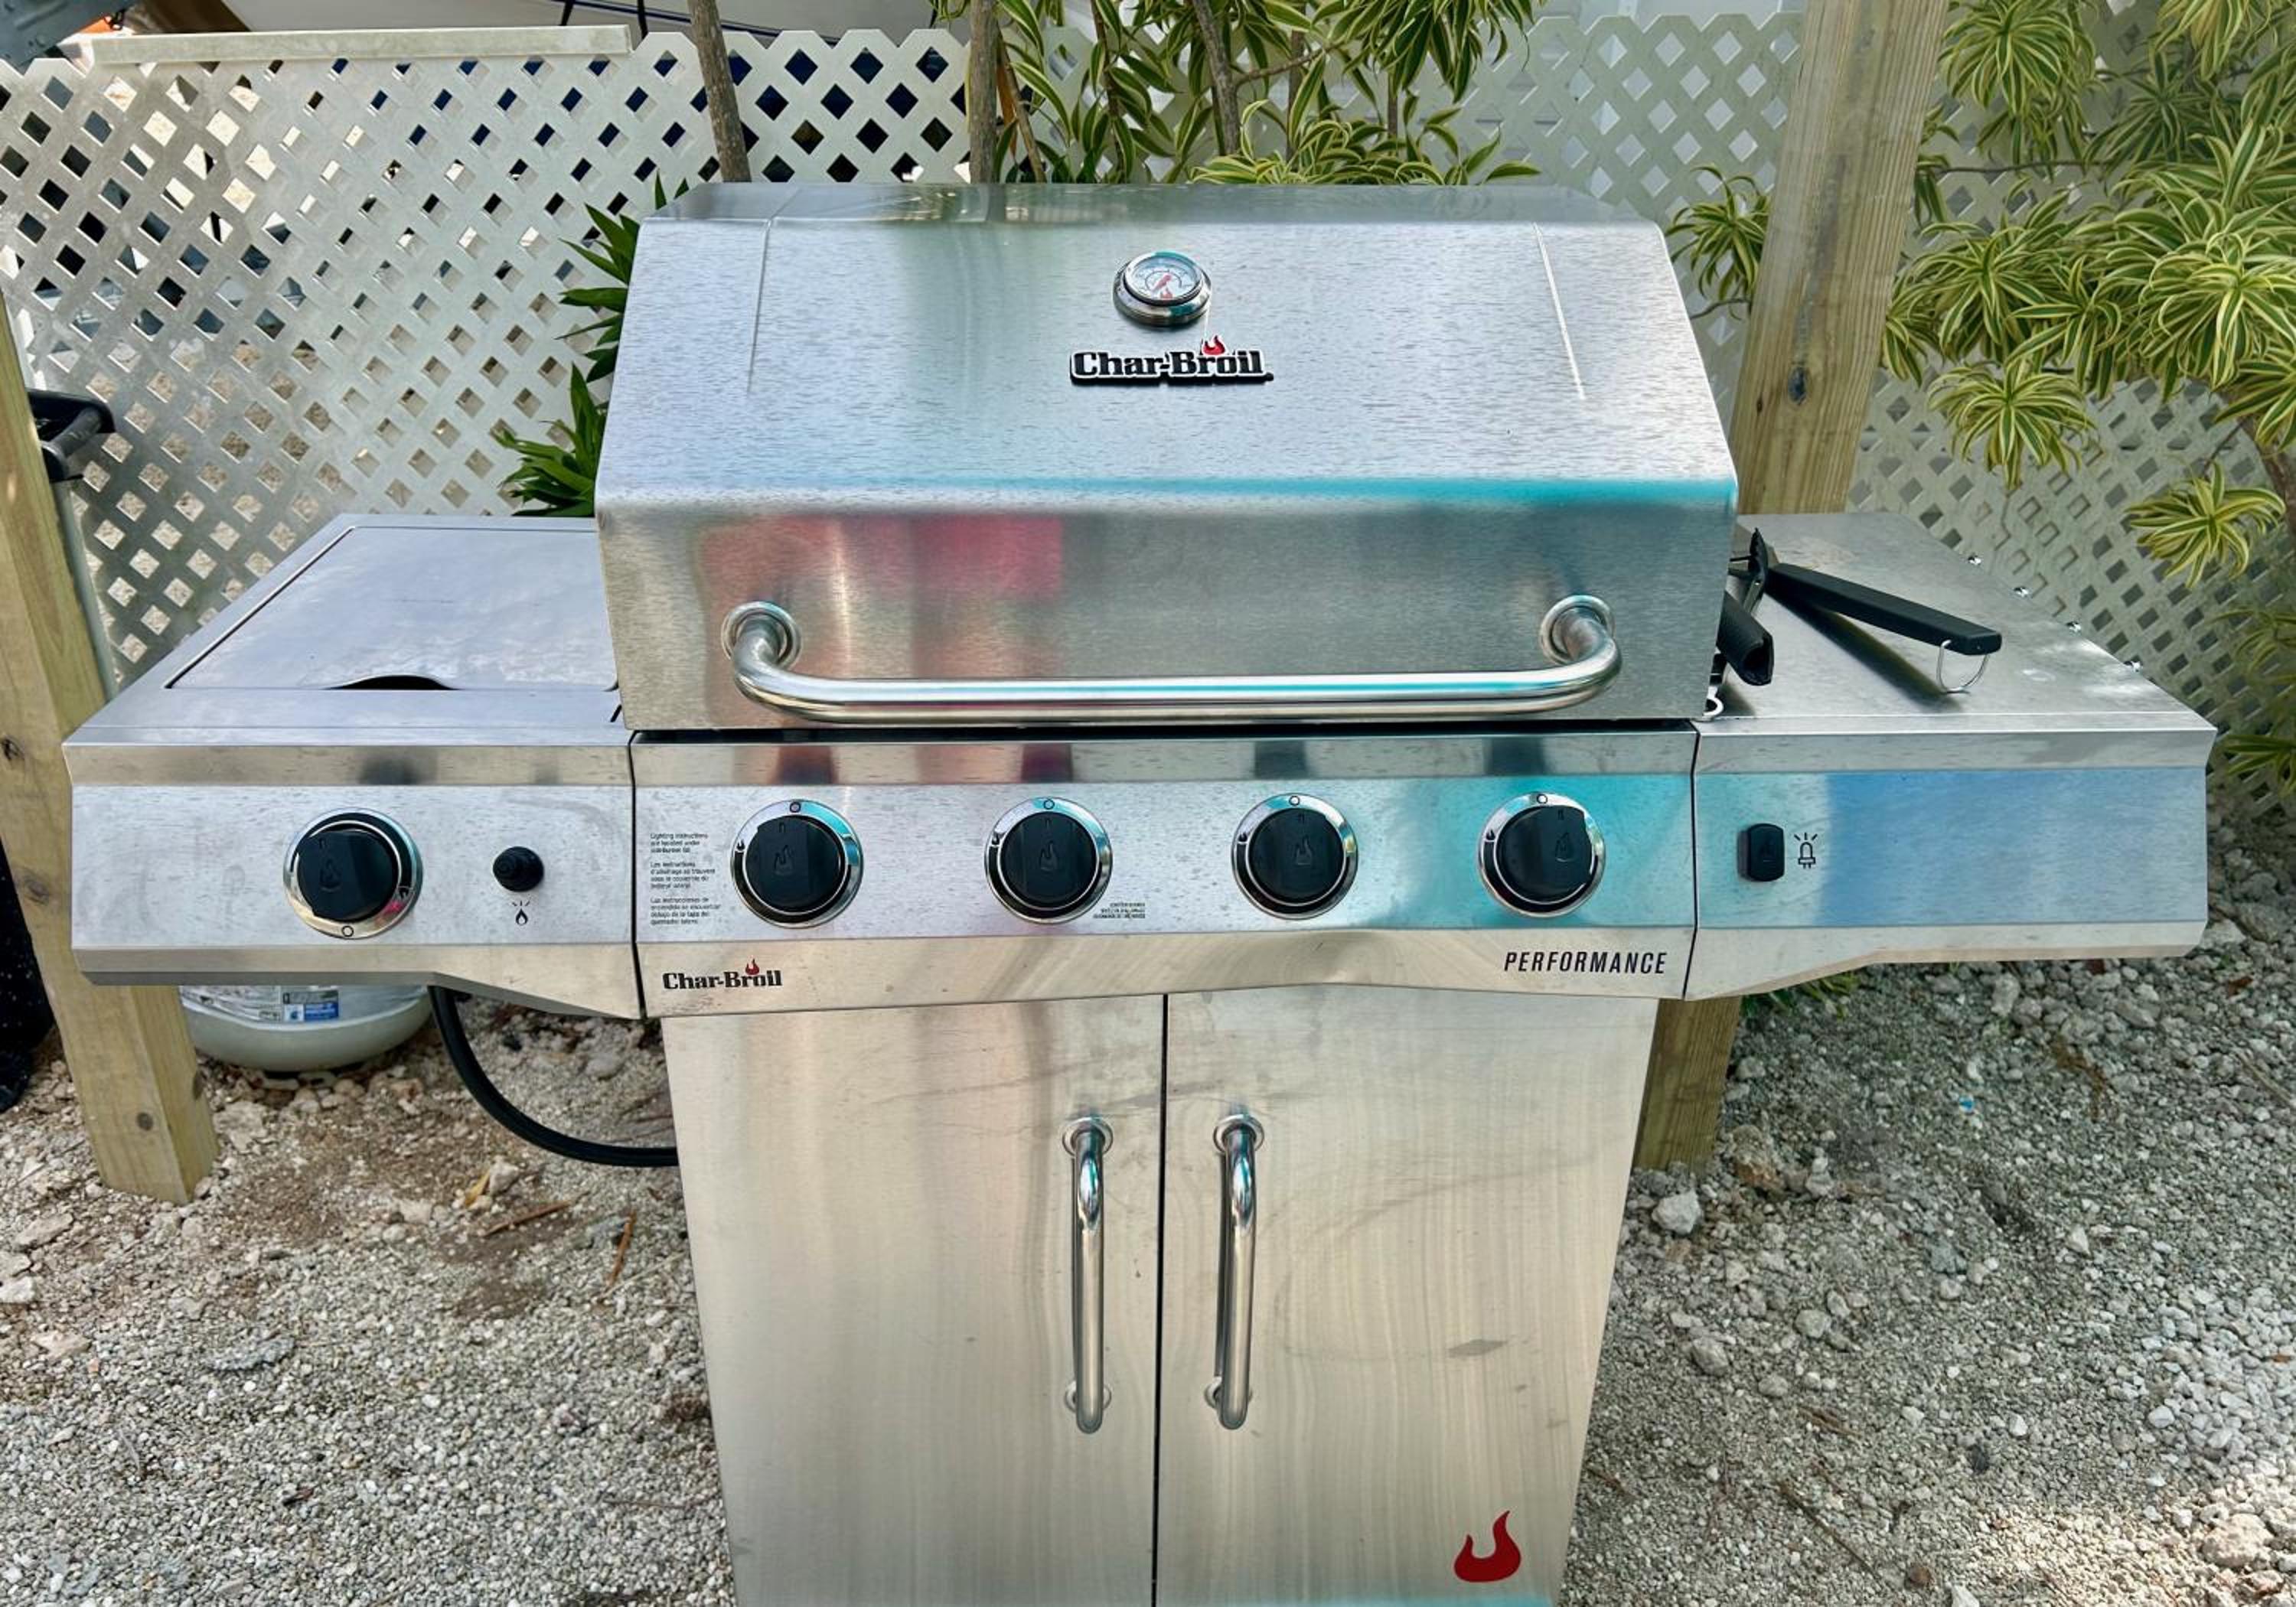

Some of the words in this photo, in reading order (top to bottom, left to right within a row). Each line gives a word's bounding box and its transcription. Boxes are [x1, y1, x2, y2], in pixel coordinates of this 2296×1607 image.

[1071, 349, 1264, 378] Char-Broil
[1504, 951, 1668, 974] PERFORMANCE
[662, 970, 783, 989] Char-Broil
